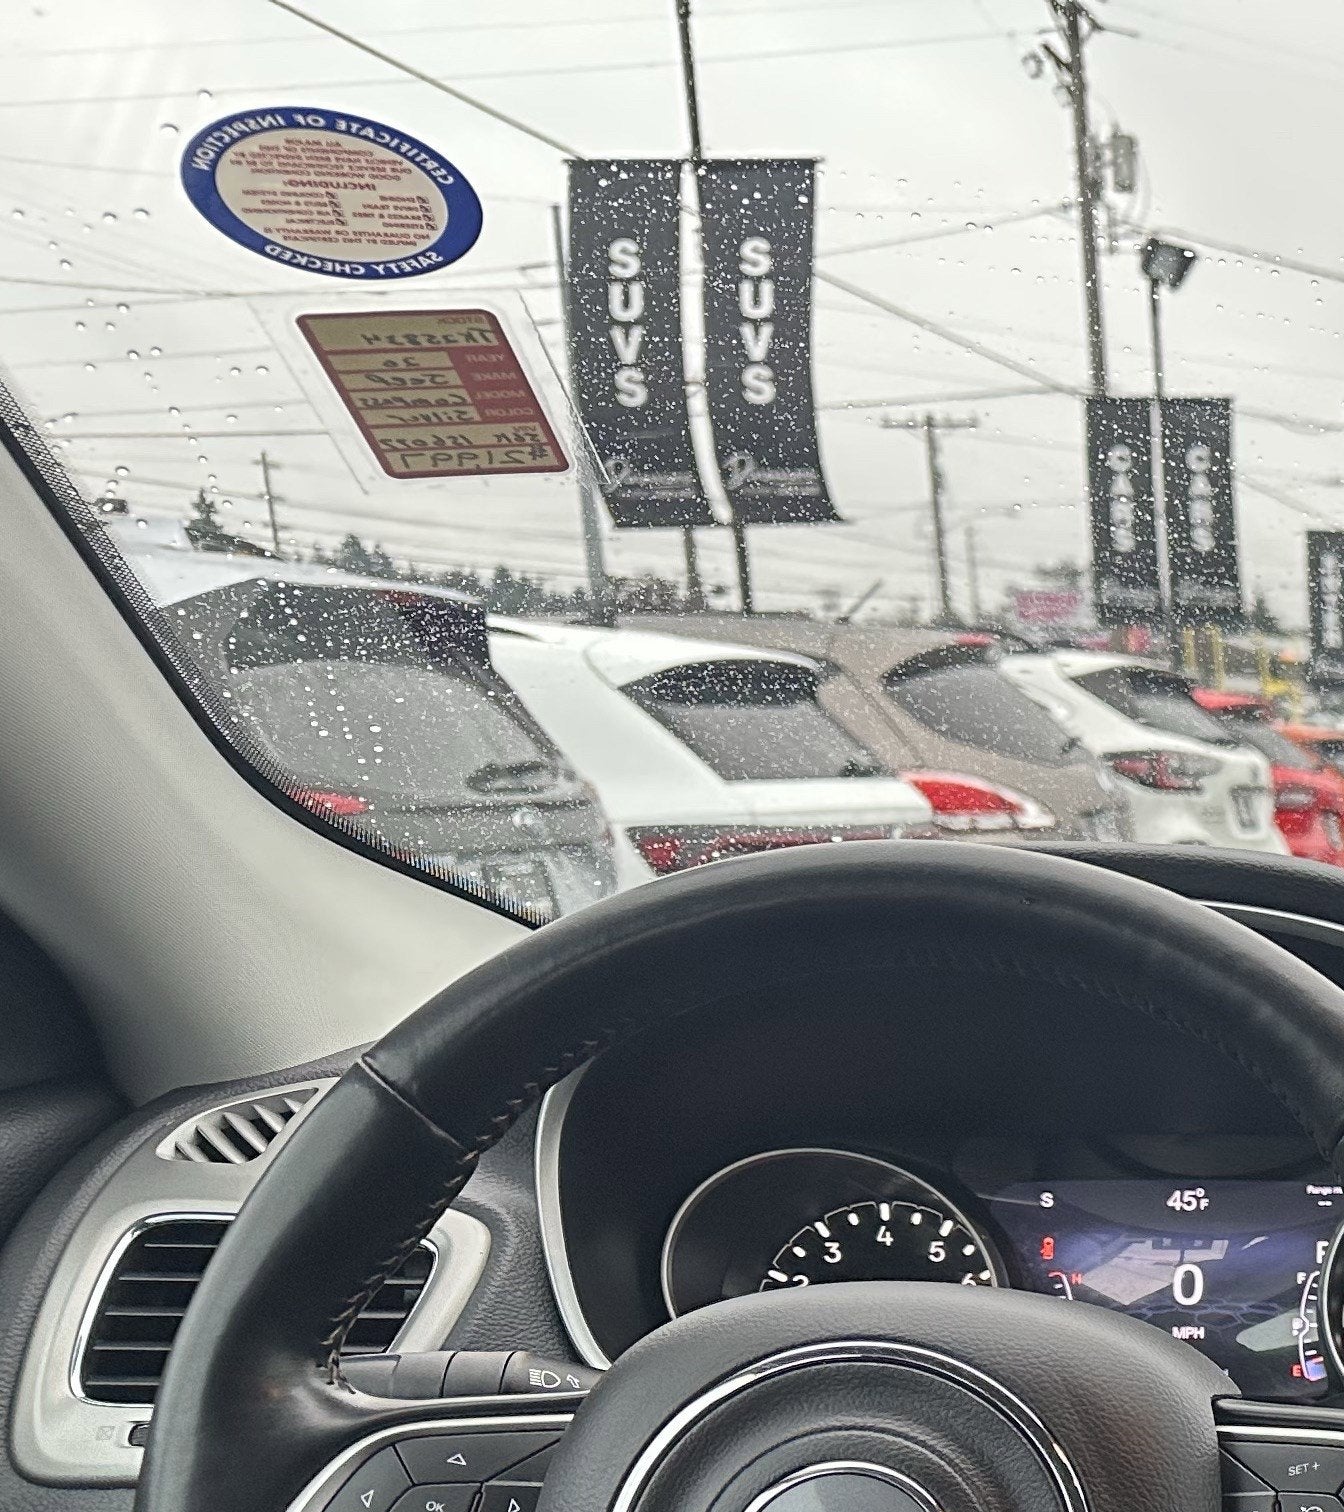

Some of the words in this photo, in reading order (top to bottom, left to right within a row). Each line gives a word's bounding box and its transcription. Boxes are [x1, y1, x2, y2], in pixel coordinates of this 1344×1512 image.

[608, 237, 648, 408] SUVS
[738, 236, 777, 405] SUVS
[1040, 1193, 1054, 1207] S
[877, 1226, 893, 1246] 4
[824, 1242, 841, 1263] 3
[929, 1242, 945, 1262] 5
[1071, 1272, 1082, 1285] H
[1172, 1263, 1204, 1306] 0
[1172, 1326, 1205, 1339] MPH
[1292, 1365, 1302, 1377] E
[1288, 1463, 1309, 1477] SET
[426, 1501, 444, 1512] OK
